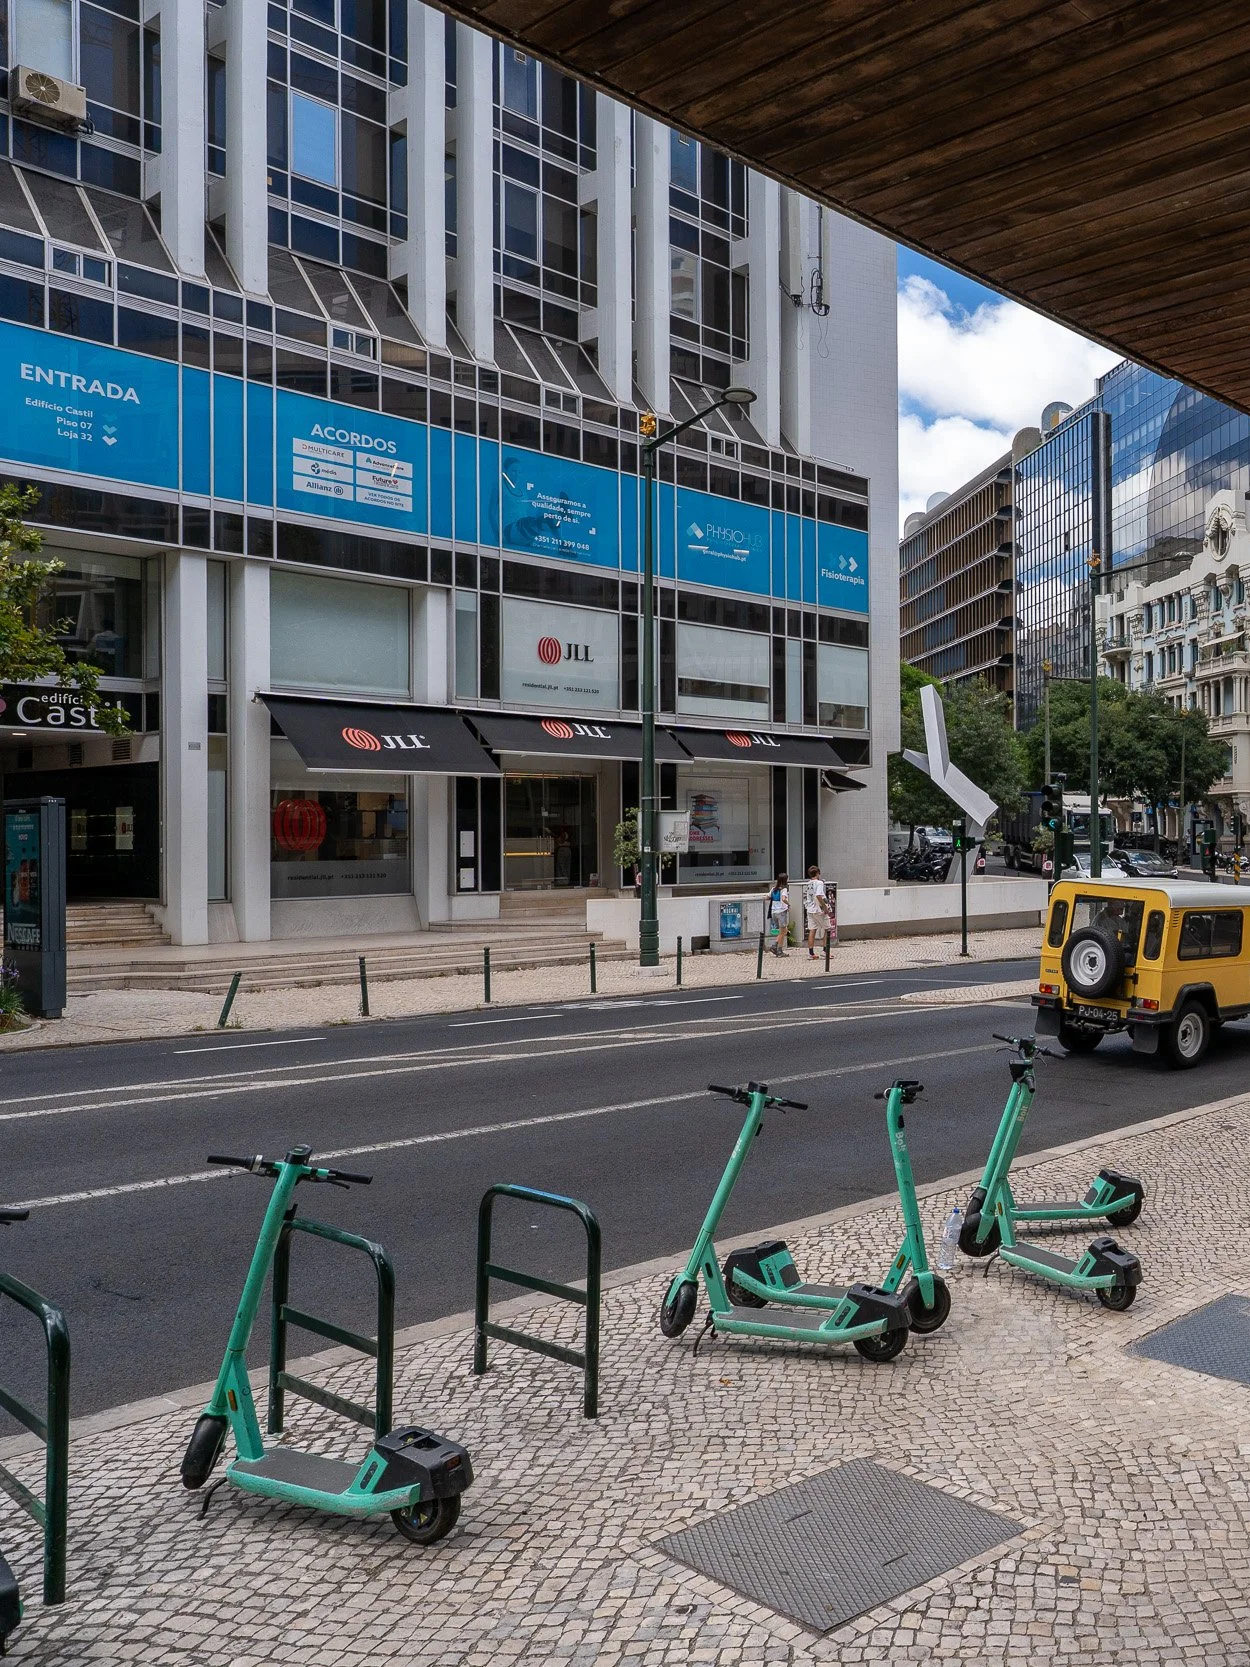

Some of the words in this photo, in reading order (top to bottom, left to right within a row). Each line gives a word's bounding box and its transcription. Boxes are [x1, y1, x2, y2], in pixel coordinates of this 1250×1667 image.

[20, 362, 140, 405] ENTRADA
[25, 397, 63, 412] Edifício
[65, 406, 93, 418] Castil
[56, 416, 78, 428] Piso
[80, 421, 93, 430] 07
[57, 428, 78, 440] Loja
[80, 432, 93, 442] 32
[310, 423, 397, 454] ACORDOS
[308, 445, 345, 458] MULTICARE
[306, 481, 333, 493] Allianz
[537, 492, 581, 508] Asseguramos
[532, 501, 566, 514] qualidade,
[567, 508, 591, 518] sempre
[543, 512, 562, 521] perto
[563, 515, 572, 523] de
[534, 535, 550, 543] +351
[551, 537, 562, 546] 211
[563, 539, 576, 548] 399
[576, 542, 590, 551] 048
[821, 568, 865, 586] Fisioterapia
[563, 642, 595, 663] JLL
[41, 693, 84, 705] edifíci
[572, 722, 611, 739] JLL
[381, 734, 430, 749] JLL
[751, 732, 781, 747] JLL
[1078, 1005, 1118, 1021] PJ-04-25
[1016, 1105, 1029, 1122] Bolt
